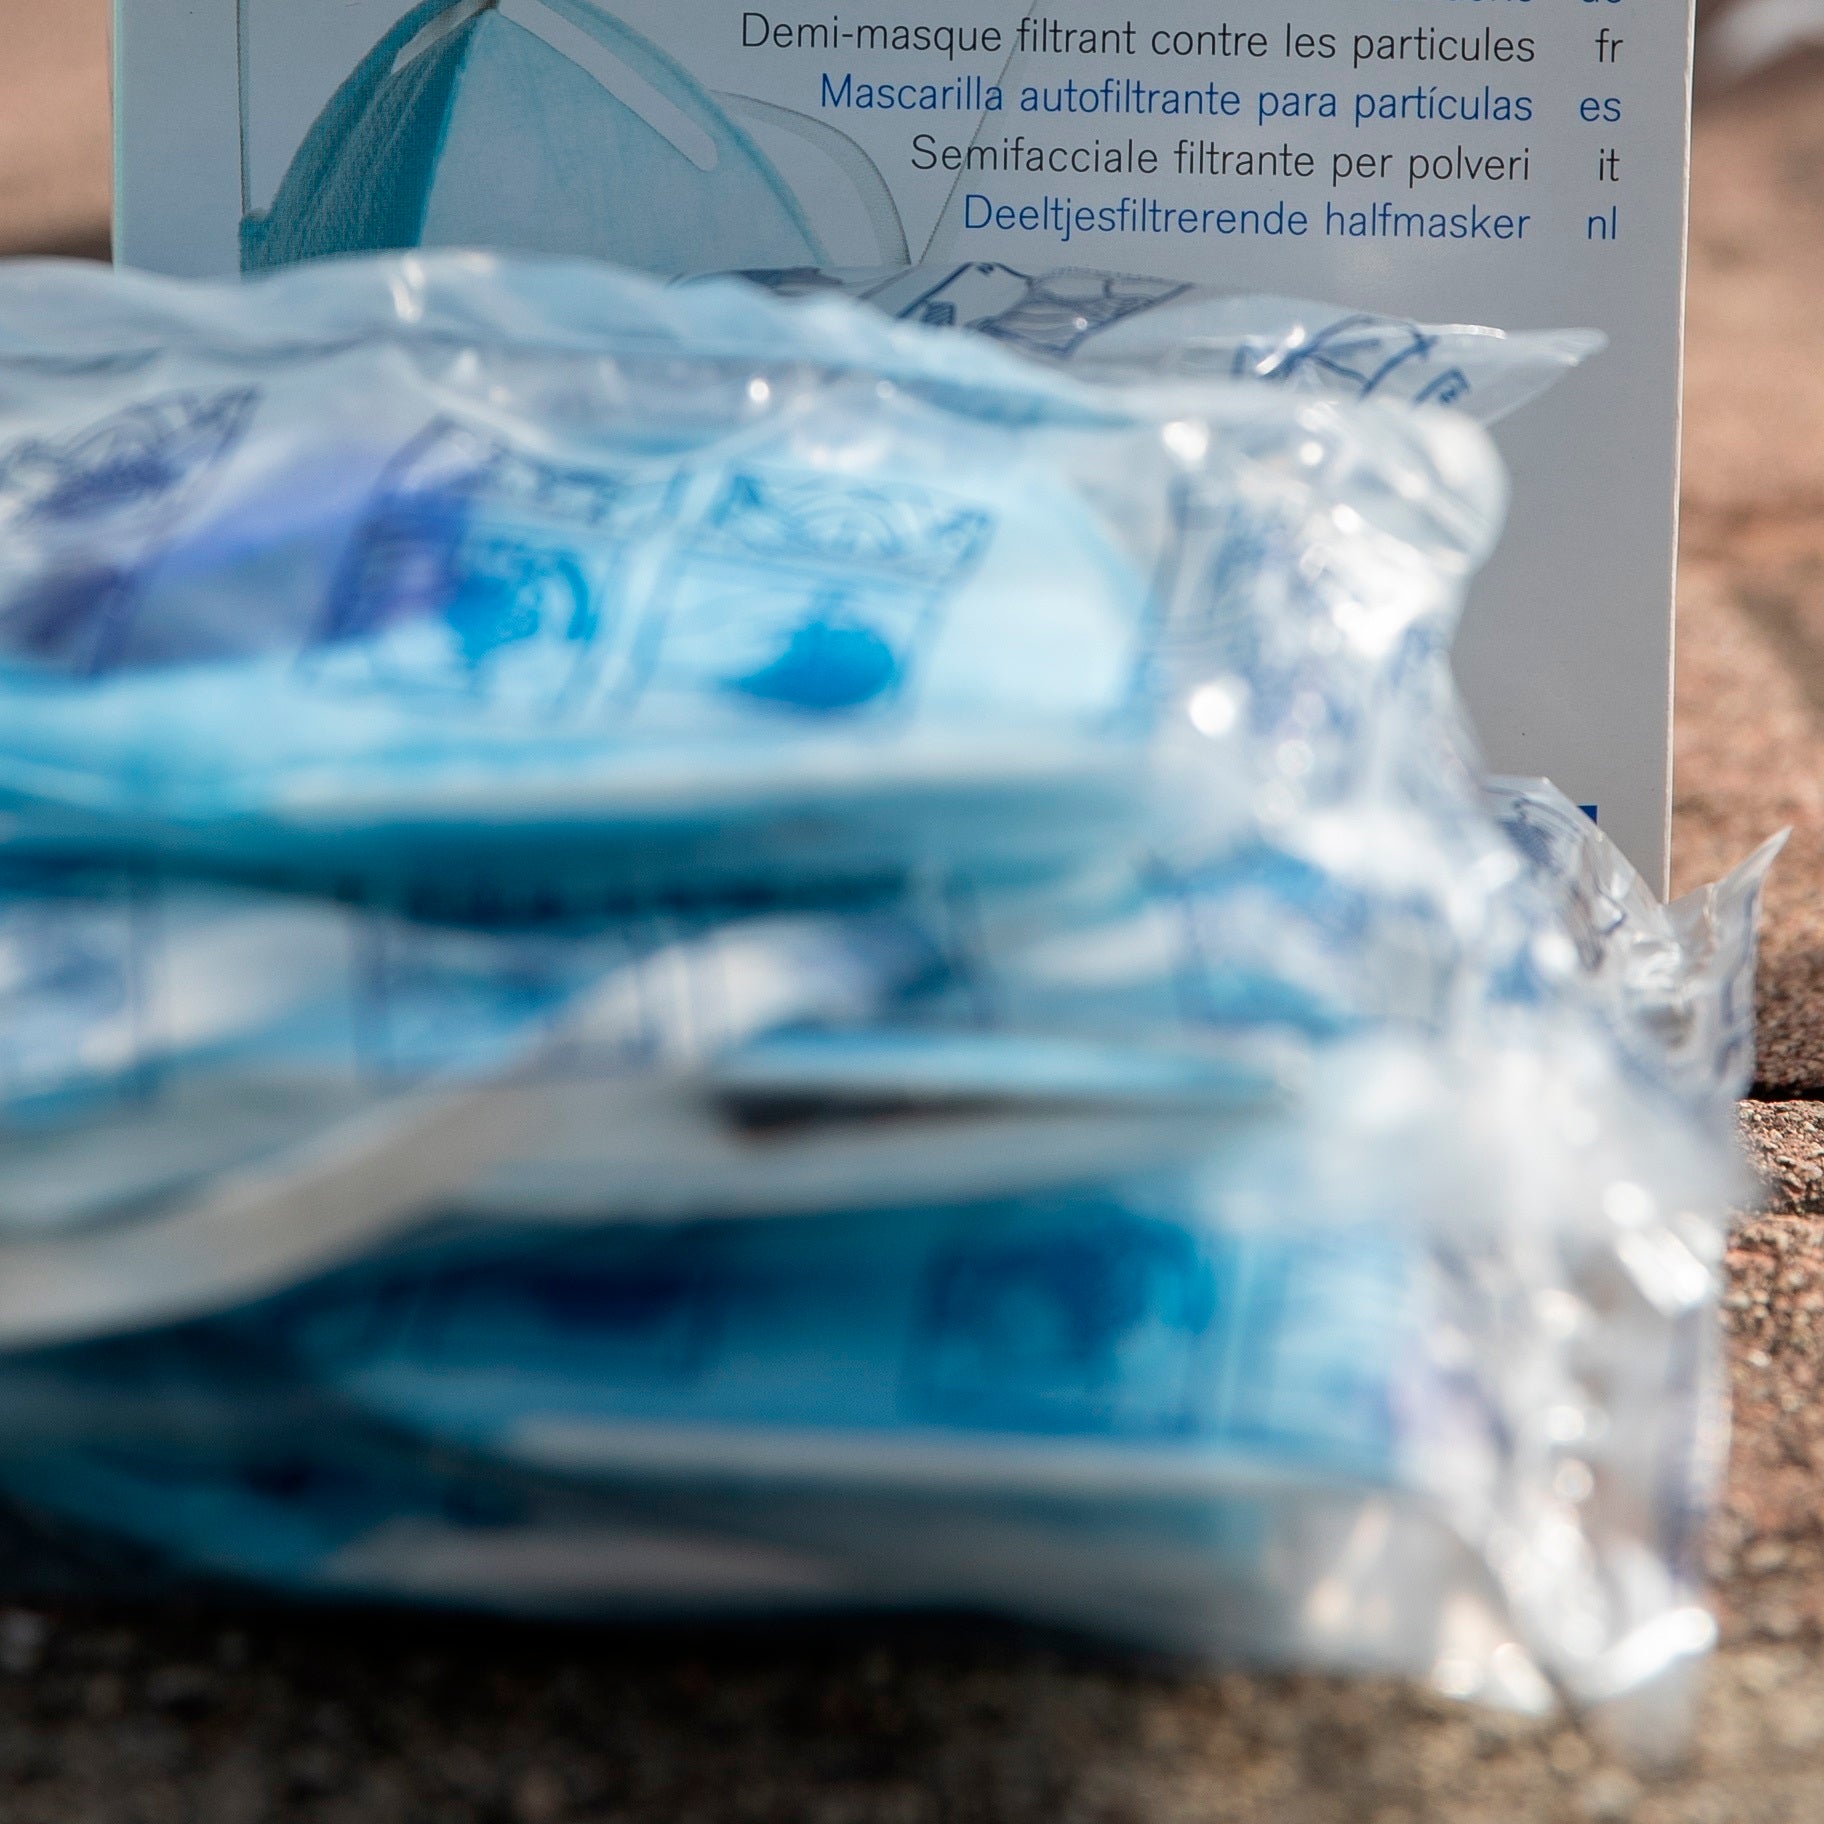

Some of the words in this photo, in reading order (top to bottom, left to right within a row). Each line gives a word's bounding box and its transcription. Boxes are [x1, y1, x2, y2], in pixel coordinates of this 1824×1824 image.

[742, 11, 1002, 60] Demi-masque
[1015, 16, 1137, 56] filtrant
[1151, 22, 1268, 58] contre
[1285, 22, 1336, 61] les
[1353, 26, 1535, 70] particules
[1594, 27, 1624, 64] fr
[821, 72, 1003, 114] Mascarilla
[1020, 77, 1241, 118] autofiltrante
[1258, 91, 1337, 127] para
[1354, 84, 1533, 129] partículas
[1579, 96, 1622, 123] es
[910, 133, 1159, 176] Semifacciale
[1173, 138, 1315, 179] filtrante
[1332, 153, 1394, 188] per
[1408, 144, 1529, 190] polveri
[1599, 147, 1621, 182] it
[964, 192, 1308, 243] Deeltjesfiltrerende
[1326, 200, 1532, 240] halfmasker
[1587, 204, 1617, 241] nl
